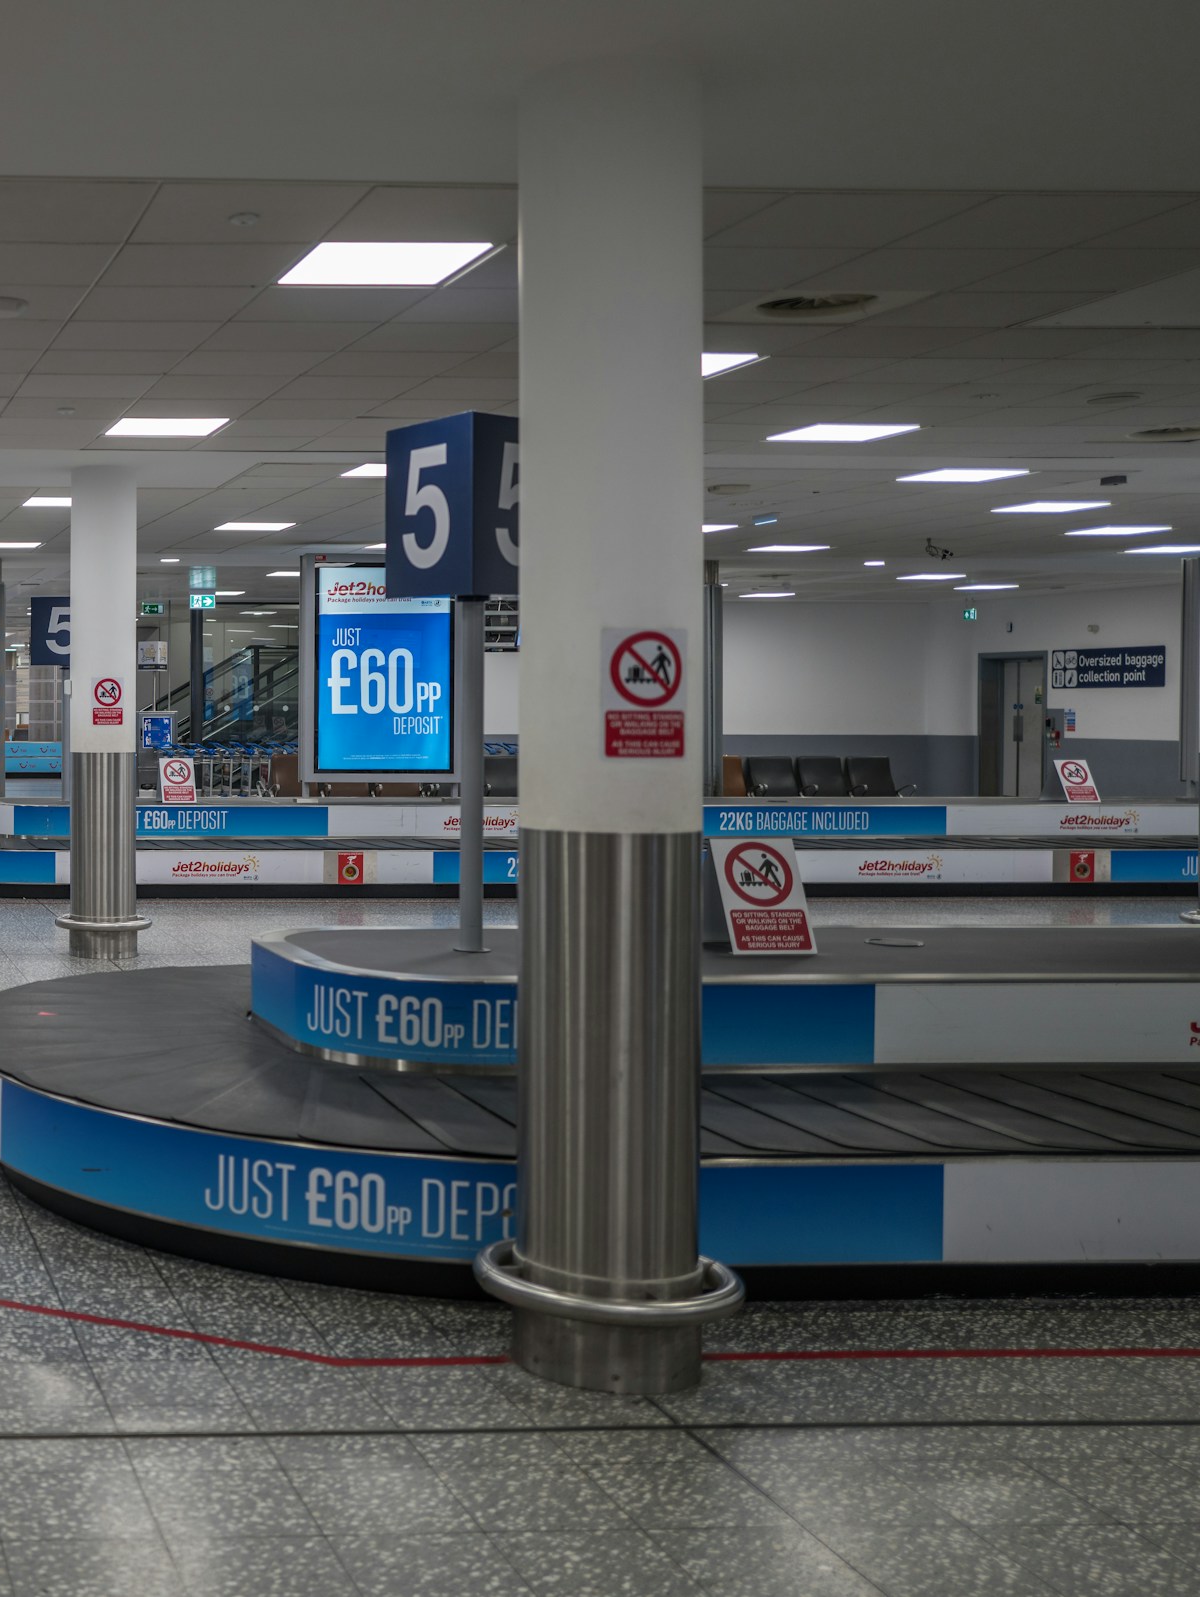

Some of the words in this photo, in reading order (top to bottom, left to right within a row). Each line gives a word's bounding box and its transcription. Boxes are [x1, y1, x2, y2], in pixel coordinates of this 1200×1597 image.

[402, 443, 450, 570] 5
[327, 582, 387, 596] Jet2ho
[45, 606, 71, 655] 5
[332, 628, 362, 647] JUST
[1078, 653, 1122, 668] Oversized
[1124, 652, 1164, 669] baggage
[1078, 670, 1121, 683] collection
[1123, 669, 1146, 684] point
[177, 810, 229, 830] DEPOSIT
[719, 811, 753, 831] 22KG
[756, 811, 809, 831] BAGGAGE
[811, 811, 870, 831] INCLUDED
[1060, 815, 1130, 828] Jet2holidays
[172, 861, 250, 875] Jet2holidays
[858, 860, 933, 874] Jet2holidays
[1182, 855, 1198, 876] JU
[307, 984, 368, 1040] JUST
[204, 1154, 296, 1222] JUST
[421, 1178, 518, 1242] DEPO
